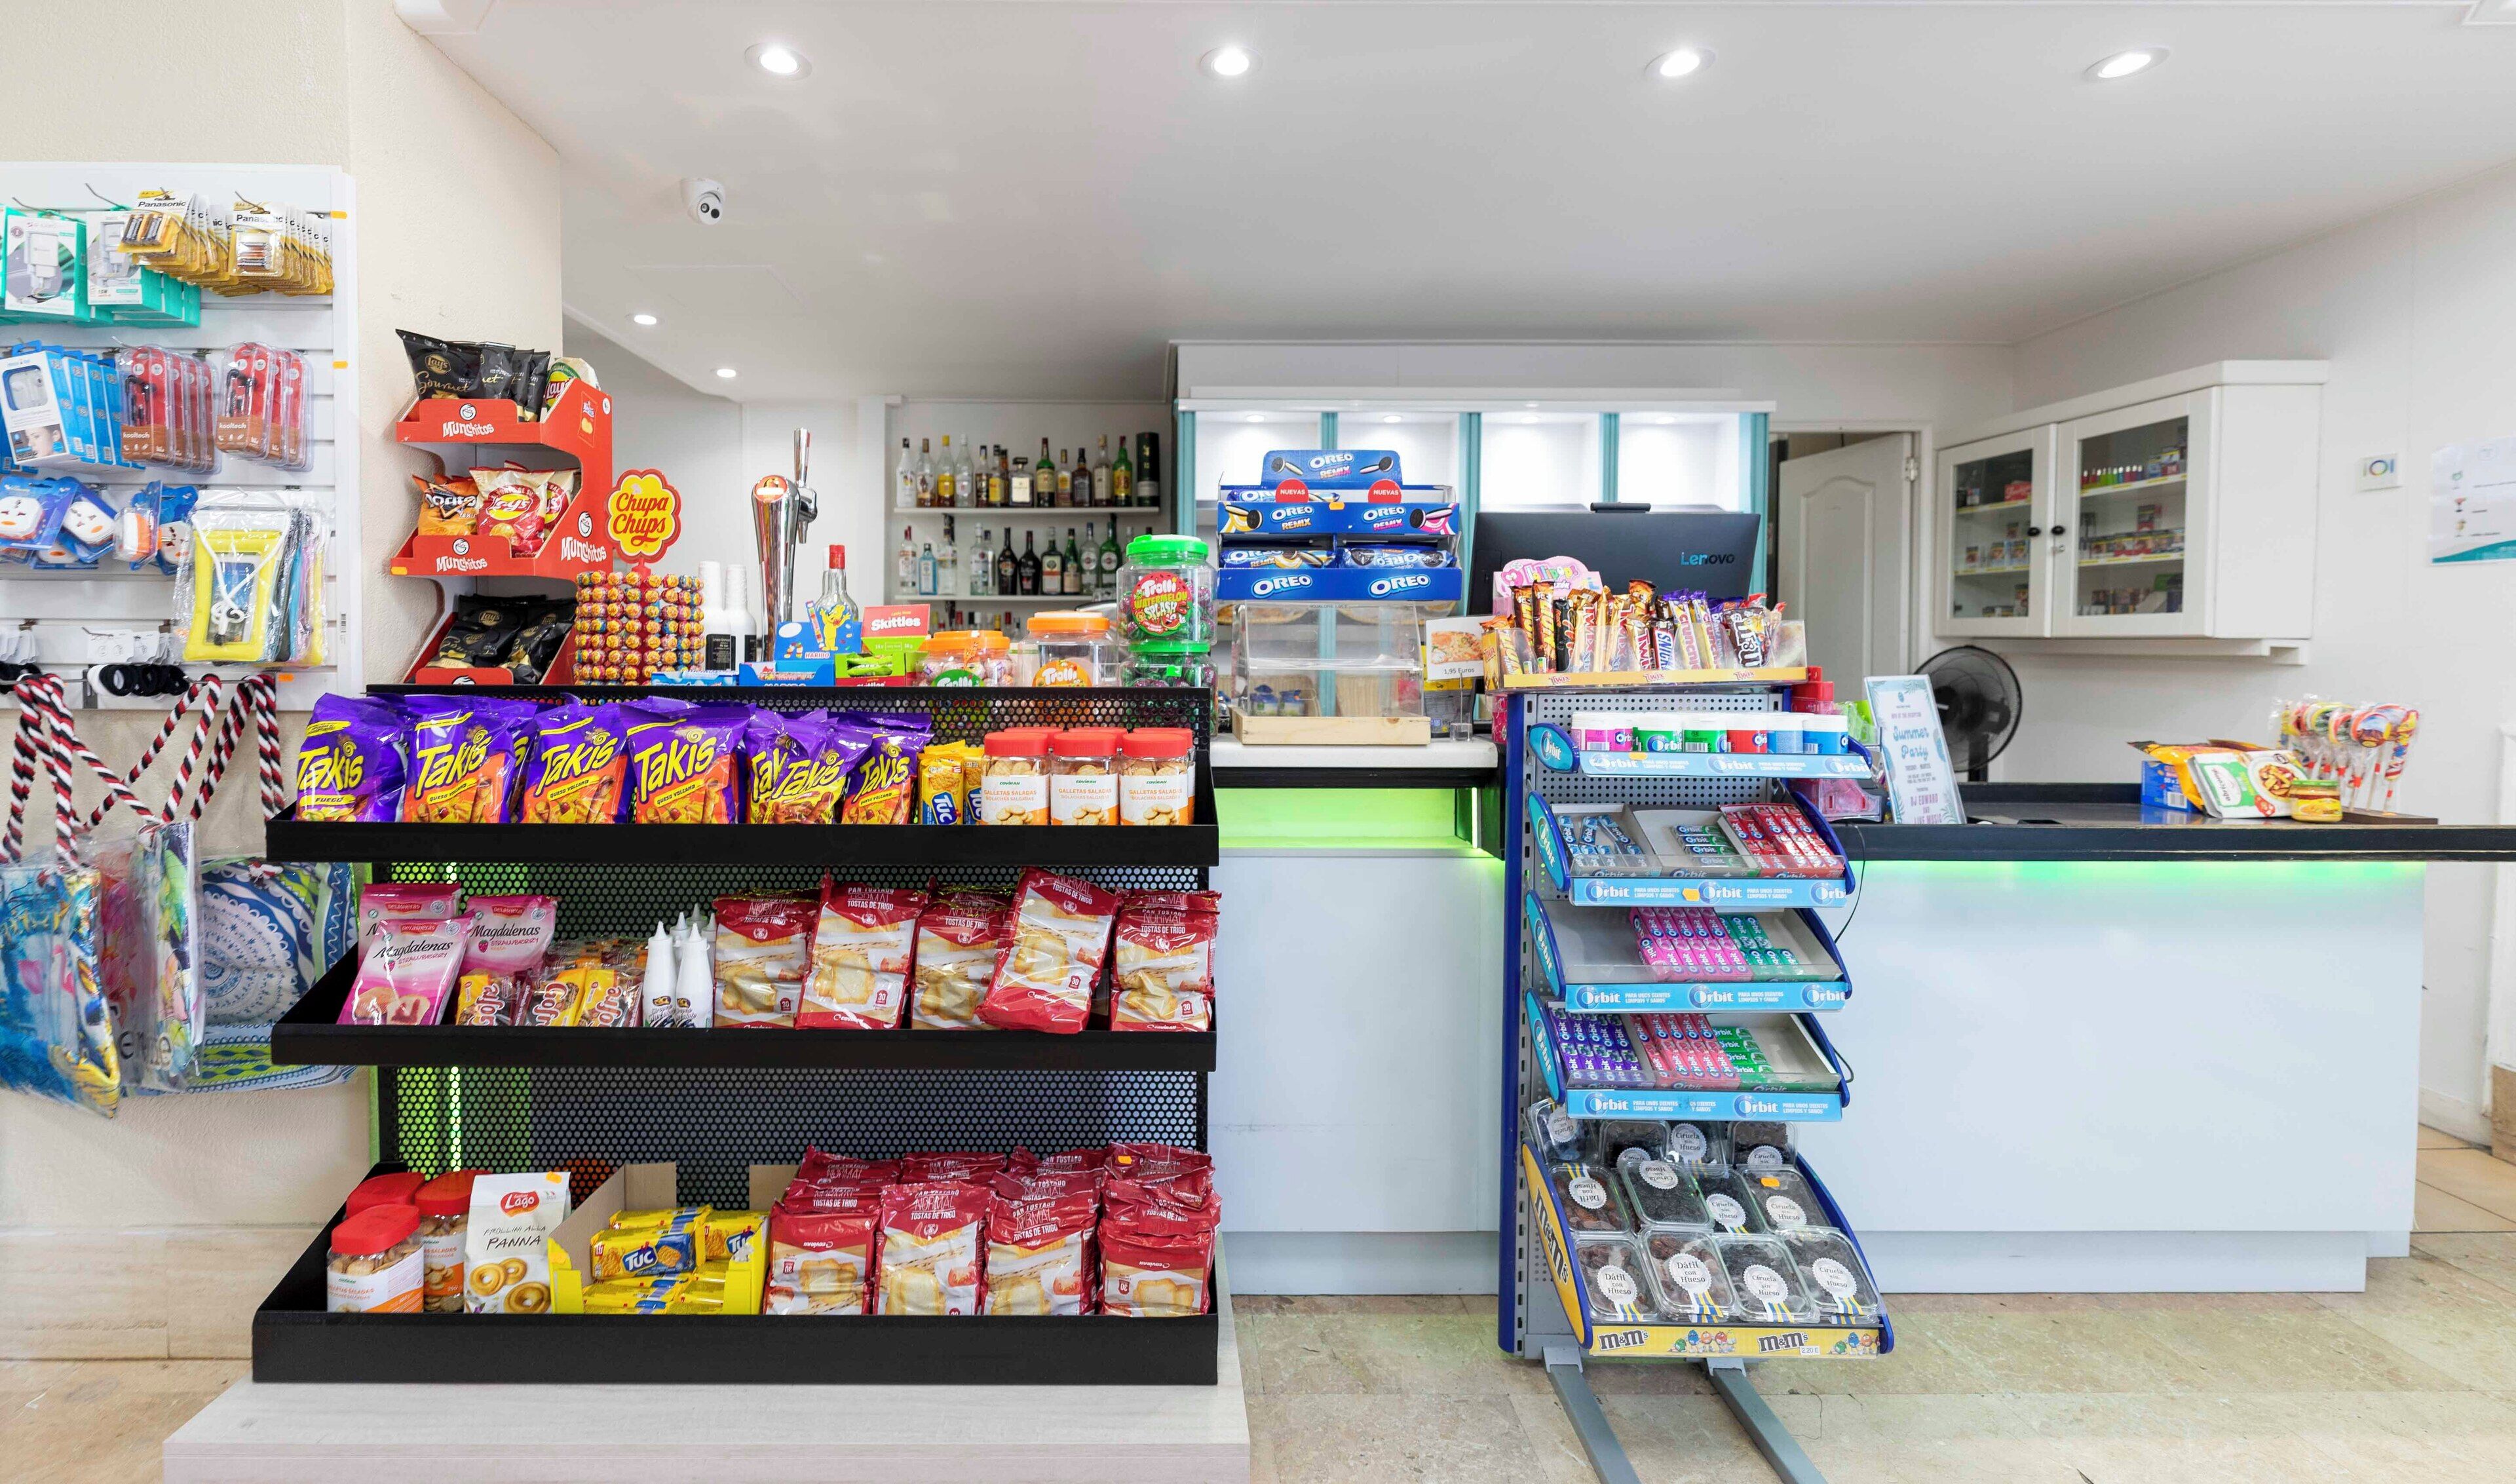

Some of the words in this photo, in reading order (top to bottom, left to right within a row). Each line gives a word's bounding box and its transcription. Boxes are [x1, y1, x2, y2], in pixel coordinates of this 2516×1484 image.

[415, 370, 470, 394] Gourmet
[1309, 453, 1355, 470] OREO
[1320, 465, 1351, 479] REMIX
[615, 491, 668, 513] Chupa
[1272, 506, 1314, 522] OREO
[1363, 506, 1406, 522] OREO
[613, 512, 666, 546] Chups
[1282, 518, 1312, 531] REMIX
[1373, 518, 1404, 531] REMIX
[1680, 552, 1735, 565] Lenovo
[1141, 577, 1177, 598] Trolli
[1252, 574, 1312, 596] OREO
[1369, 574, 1430, 596] OREO
[1134, 592, 1188, 609] WATERMELON
[1143, 601, 1178, 620] SPLASH
[871, 617, 921, 632] Skittles
[1041, 664, 1078, 686] Trolli
[1893, 725, 1930, 742] Summer
[1901, 744, 1930, 761] Party
[297, 741, 364, 791] Takis
[415, 729, 492, 799] Takis
[535, 731, 619, 796] Takis
[634, 728, 717, 802] Takis
[772, 752, 845, 799] Takis
[853, 742, 911, 803] Takis
[429, 793, 448, 801] QUESO
[549, 789, 567, 799] QUESO
[567, 779, 590, 791] VOLCANO
[656, 795, 673, 805] QUESO
[673, 784, 696, 796] VOLCANO
[873, 792, 893, 801] VOLCANO
[934, 795, 952, 822] TUC
[1677, 825, 1702, 834] Orbit
[1686, 836, 1709, 845] Orbit
[1692, 845, 1717, 854] Orbit
[1052, 883, 1071, 897] TOSTAS
[1071, 890, 1079, 899] DE
[1078, 894, 1092, 905] TRIGO
[847, 900, 867, 909] TOSTAS
[877, 902, 894, 911] TRIGO
[470, 924, 541, 940] Magdalenas
[945, 918, 965, 927] TOSTAS
[974, 921, 989, 930] TRIGO
[1140, 925, 1161, 934] TOSTAS
[1162, 926, 1170, 934] DE
[1170, 926, 1186, 934] TRIGO
[372, 940, 453, 959] Magdalenas
[491, 937, 539, 946] STRAWBERRY
[1640, 937, 1657, 959] Orbit
[397, 951, 449, 965] STRAWBERRY
[1072, 978, 1080, 986] 30
[1558, 1021, 1570, 1040] Orbit
[1574, 1022, 1586, 1042] Orbit
[1589, 1023, 1601, 1042] Orbit
[1601, 1028, 1613, 1047] Orbit
[1614, 1027, 1628, 1048] Orbit
[505, 1196, 535, 1209] Lago
[812, 1199, 833, 1208] TOSTAS
[833, 1199, 841, 1208] DE
[841, 1199, 858, 1208] TRIGO
[911, 1212, 931, 1221] TOSTAS
[941, 1211, 956, 1219] TRIGO
[484, 1226, 522, 1237] FROLLINI
[1013, 1230, 1033, 1241] TOSTAS
[1033, 1228, 1041, 1236] DE
[1041, 1223, 1059, 1234] TRIGO
[486, 1235, 542, 1251] PANNA
[624, 1252, 655, 1271] TUC
[1676, 1261, 1700, 1270] Dátil
[1605, 1272, 1626, 1282] Dátil
[1753, 1274, 1779, 1283] Ciruela
[1827, 1280, 1848, 1288] Hueso
[1607, 1287, 1631, 1295] Hueso
